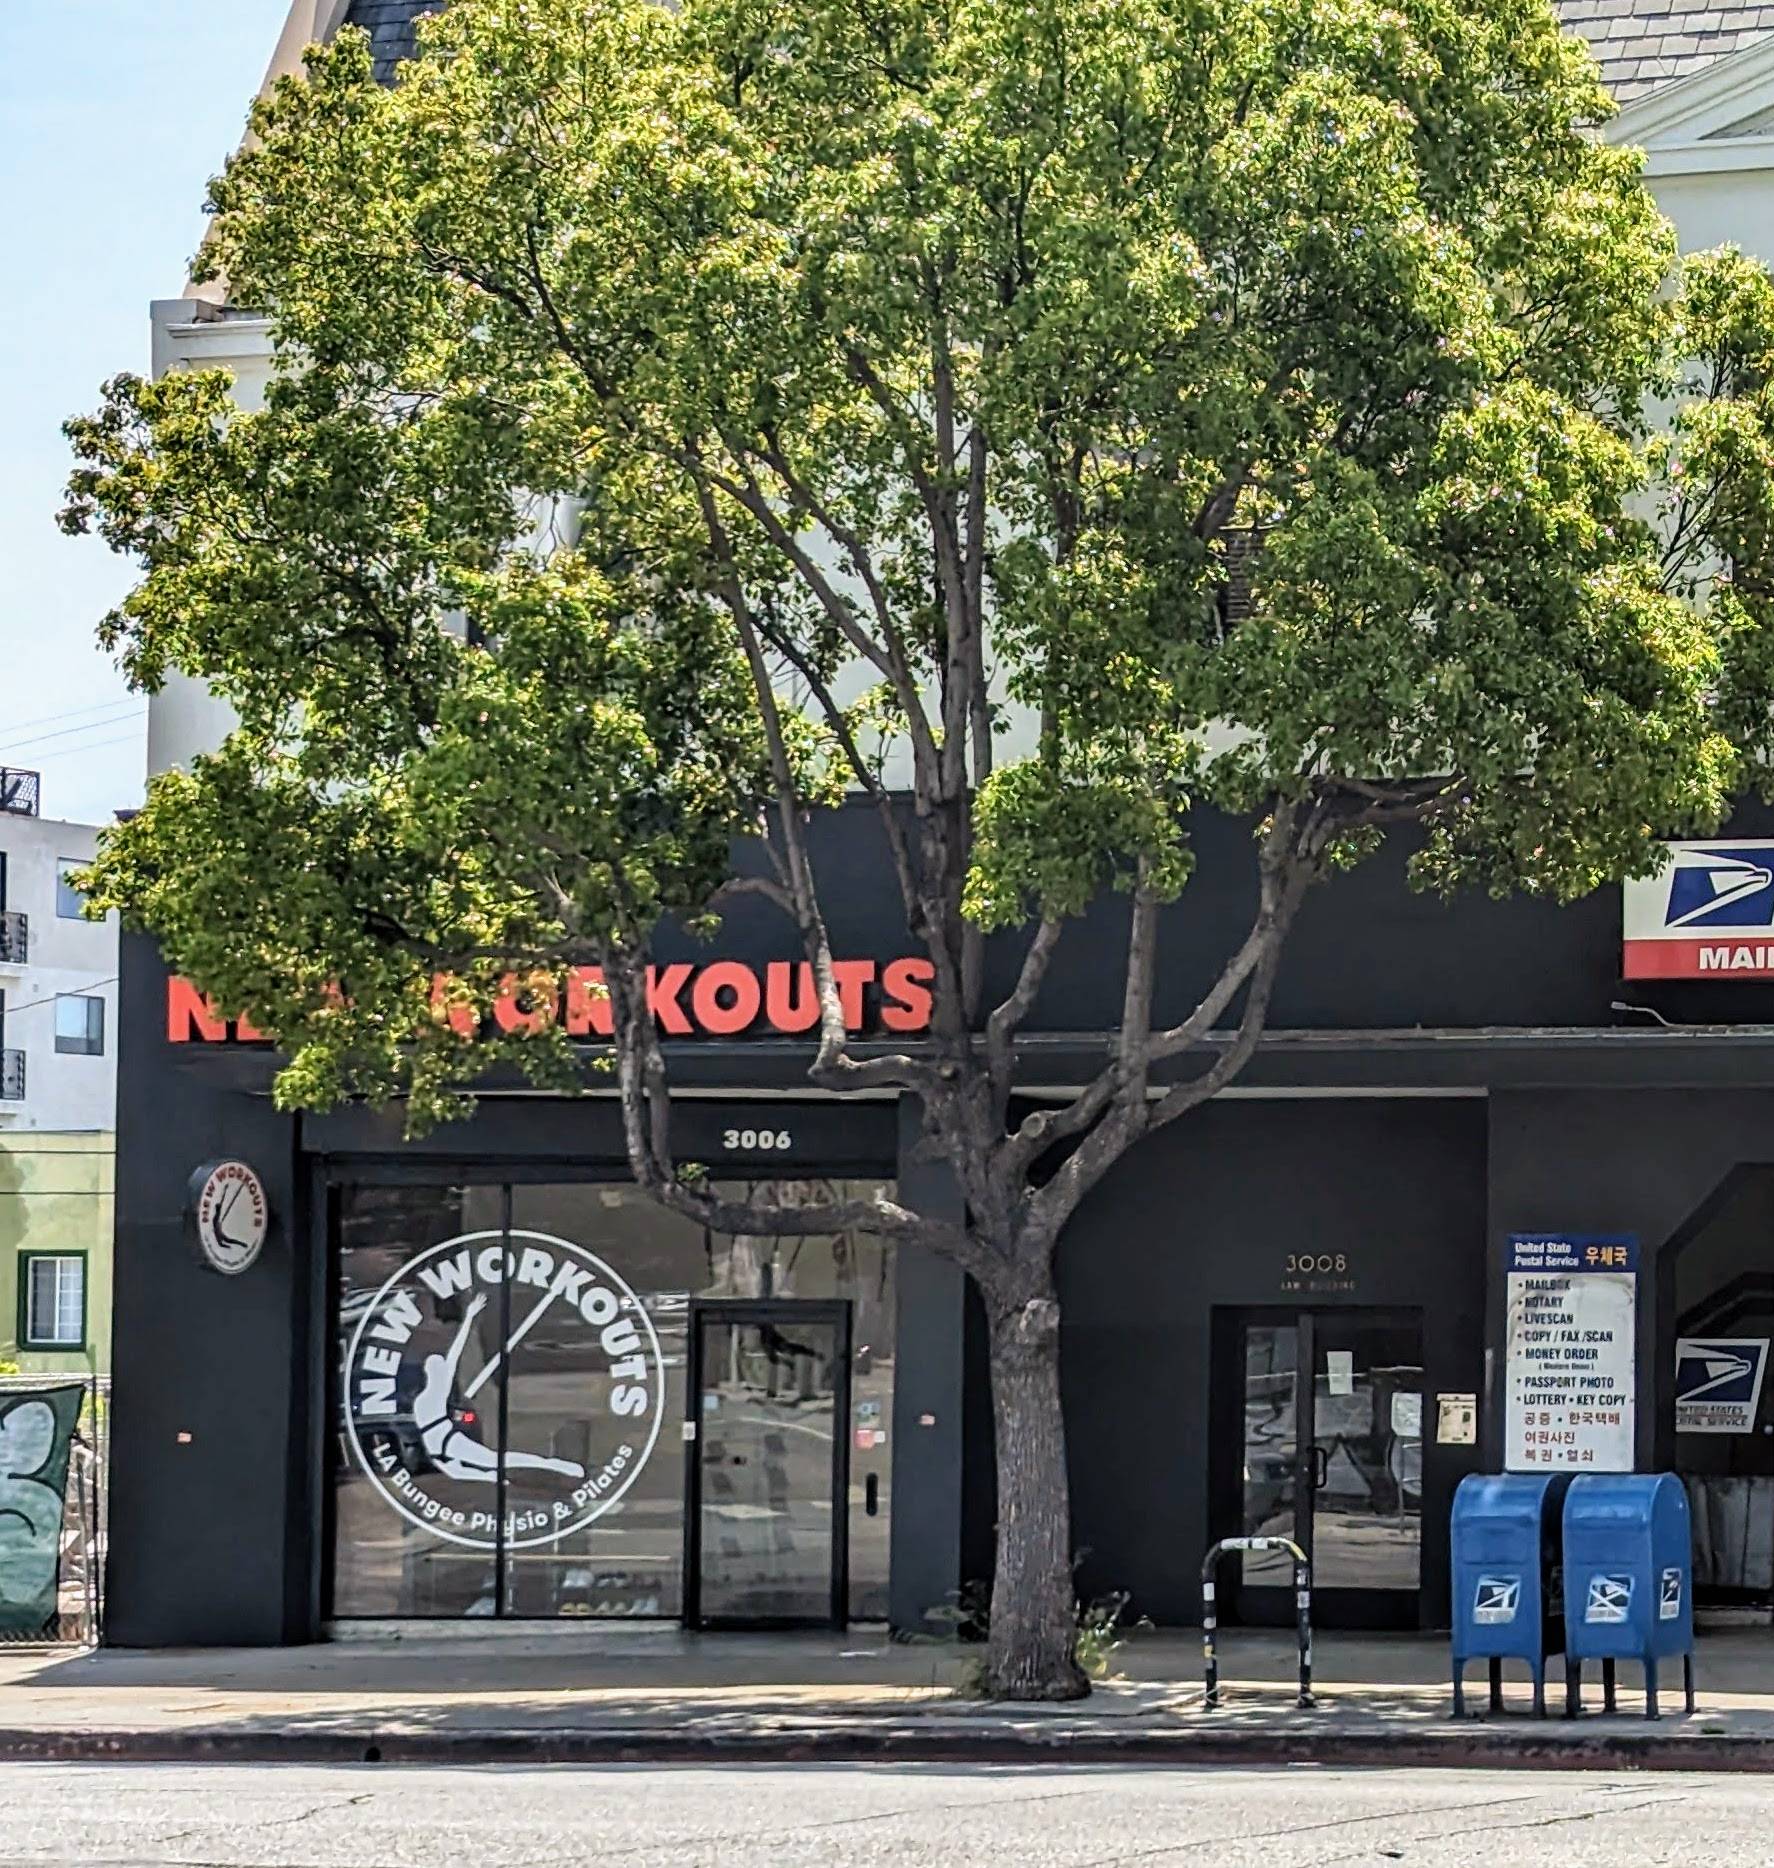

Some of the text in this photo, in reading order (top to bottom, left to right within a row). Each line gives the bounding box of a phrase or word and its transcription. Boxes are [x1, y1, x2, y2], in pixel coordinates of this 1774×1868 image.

[723, 1129, 791, 1150] 3006
[1514, 1242, 1545, 1253] United
[1514, 1256, 1579, 1266] Postal Service
[1585, 1246, 1628, 1266] 우체국
[1286, 1254, 1346, 1272] 3008
[1525, 1280, 1570, 1290] MAILBOX
[1525, 1297, 1564, 1308] NOTARY
[1524, 1313, 1574, 1324] LIVESCAN
[360, 1246, 648, 1417] NEW WORKOUTS
[1524, 1331, 1551, 1342] COPY
[1561, 1331, 1580, 1342] FAX
[1525, 1348, 1598, 1359] MONEY ORDER
[1524, 1376, 1614, 1388] PASSPORT PHOTO
[1524, 1394, 1627, 1405] LOTTERY KEY COPY
[373, 1443, 633, 1537] LA Bungee Physio & Pilates
